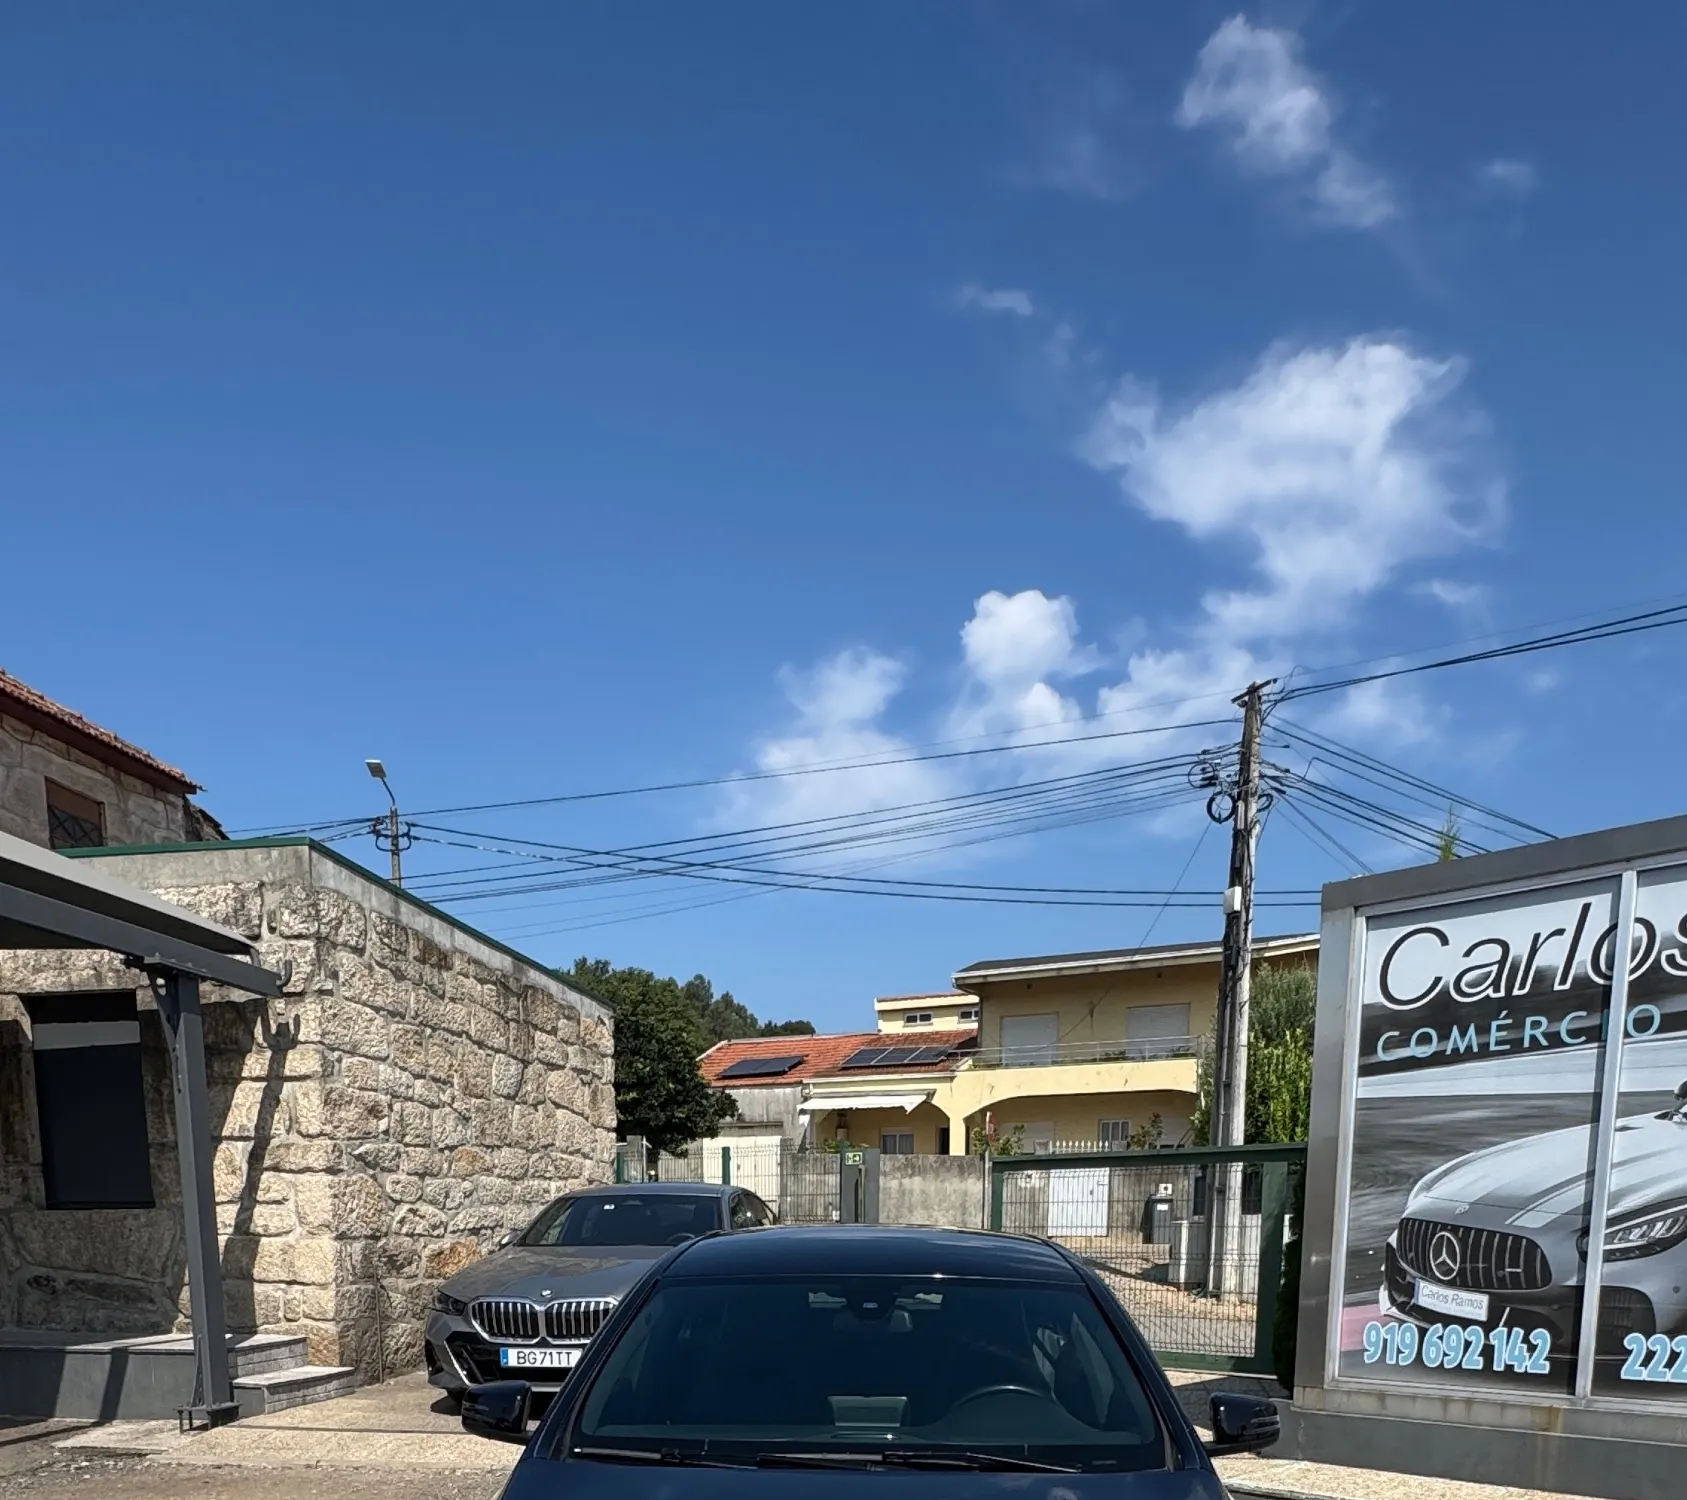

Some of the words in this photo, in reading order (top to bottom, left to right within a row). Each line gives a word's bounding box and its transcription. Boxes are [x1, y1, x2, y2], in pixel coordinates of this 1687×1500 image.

[1376, 1004, 1661, 1062] COMÉRCIO
[1421, 1285, 1449, 1304] Carlos
[1452, 1293, 1484, 1310] Ramos
[1363, 1321, 1419, 1366] 919
[1422, 1323, 1484, 1370] 692
[1489, 1327, 1551, 1374] 142
[1621, 1332, 1687, 1383] 222
